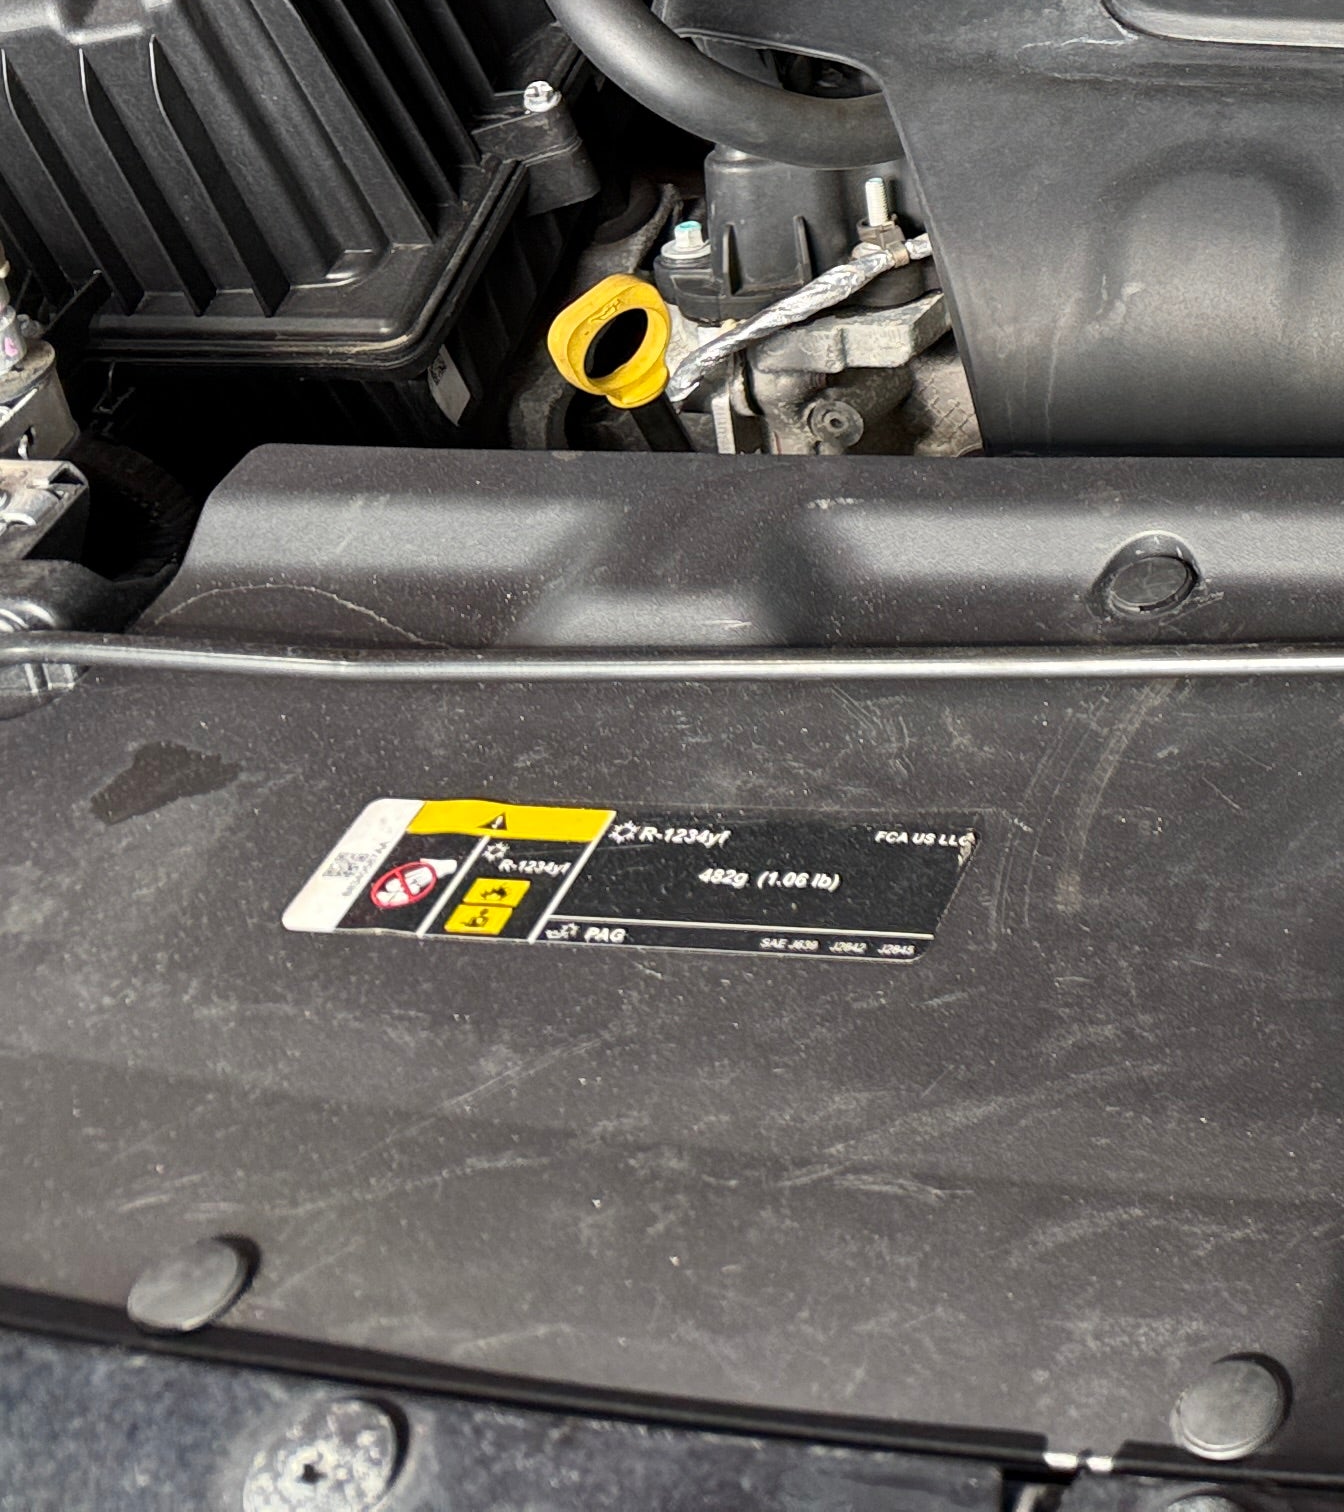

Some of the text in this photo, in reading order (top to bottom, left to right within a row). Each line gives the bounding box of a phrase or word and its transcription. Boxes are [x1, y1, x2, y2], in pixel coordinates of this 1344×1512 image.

[639, 826, 731, 848] R-1234yf
[874, 830, 909, 845] FCA
[912, 831, 936, 845] US
[498, 858, 572, 877] R-1234yf
[697, 868, 843, 891] 482g (1.06 lb)
[584, 926, 628, 944] PAG
[759, 937, 787, 950] SAE
